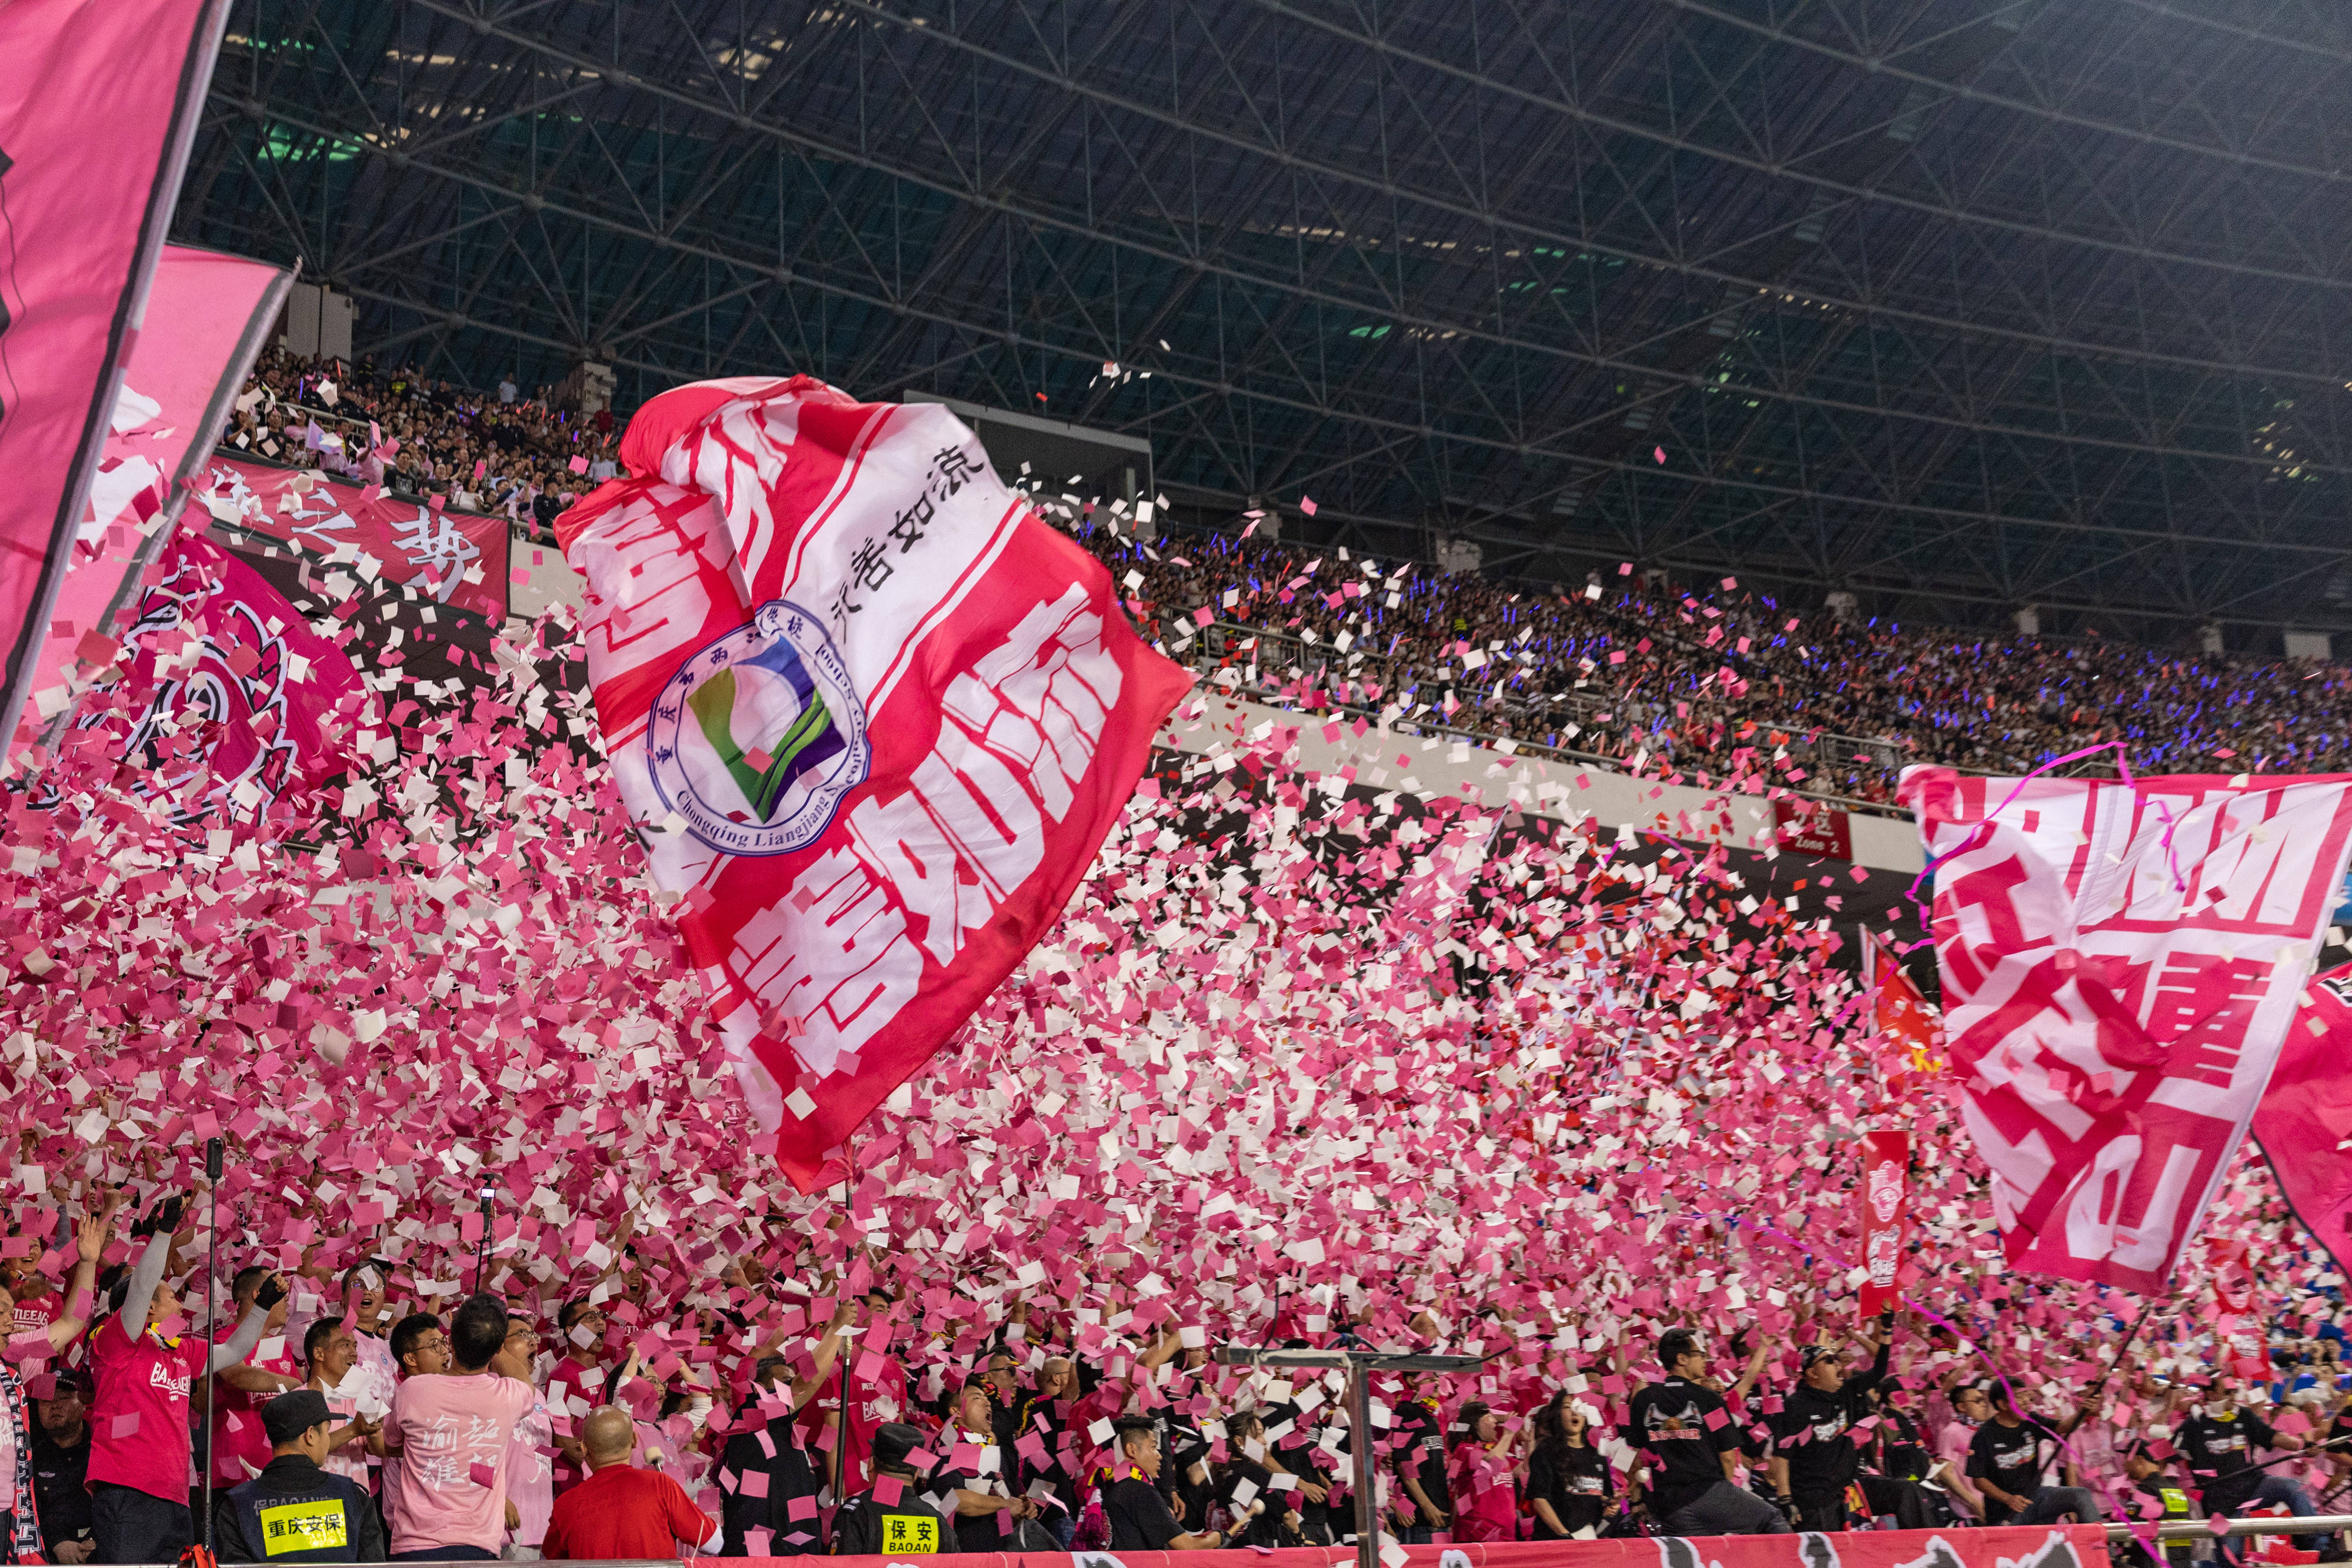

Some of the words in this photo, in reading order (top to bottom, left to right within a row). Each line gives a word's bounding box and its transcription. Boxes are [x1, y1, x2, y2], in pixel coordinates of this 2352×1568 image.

[814, 644, 853, 701] School
[824, 707, 864, 798] Sconry
[676, 790, 750, 847] Chongqing
[753, 796, 830, 847] Liangjiang
[1795, 835, 1825, 851] Zone
[1830, 841, 1839, 853] 2
[423, 1414, 502, 1452] 渝超
[268, 1514, 340, 1538] 重庆安保
[891, 1520, 931, 1541] 保安
[889, 1542, 931, 1552] BAOAN
